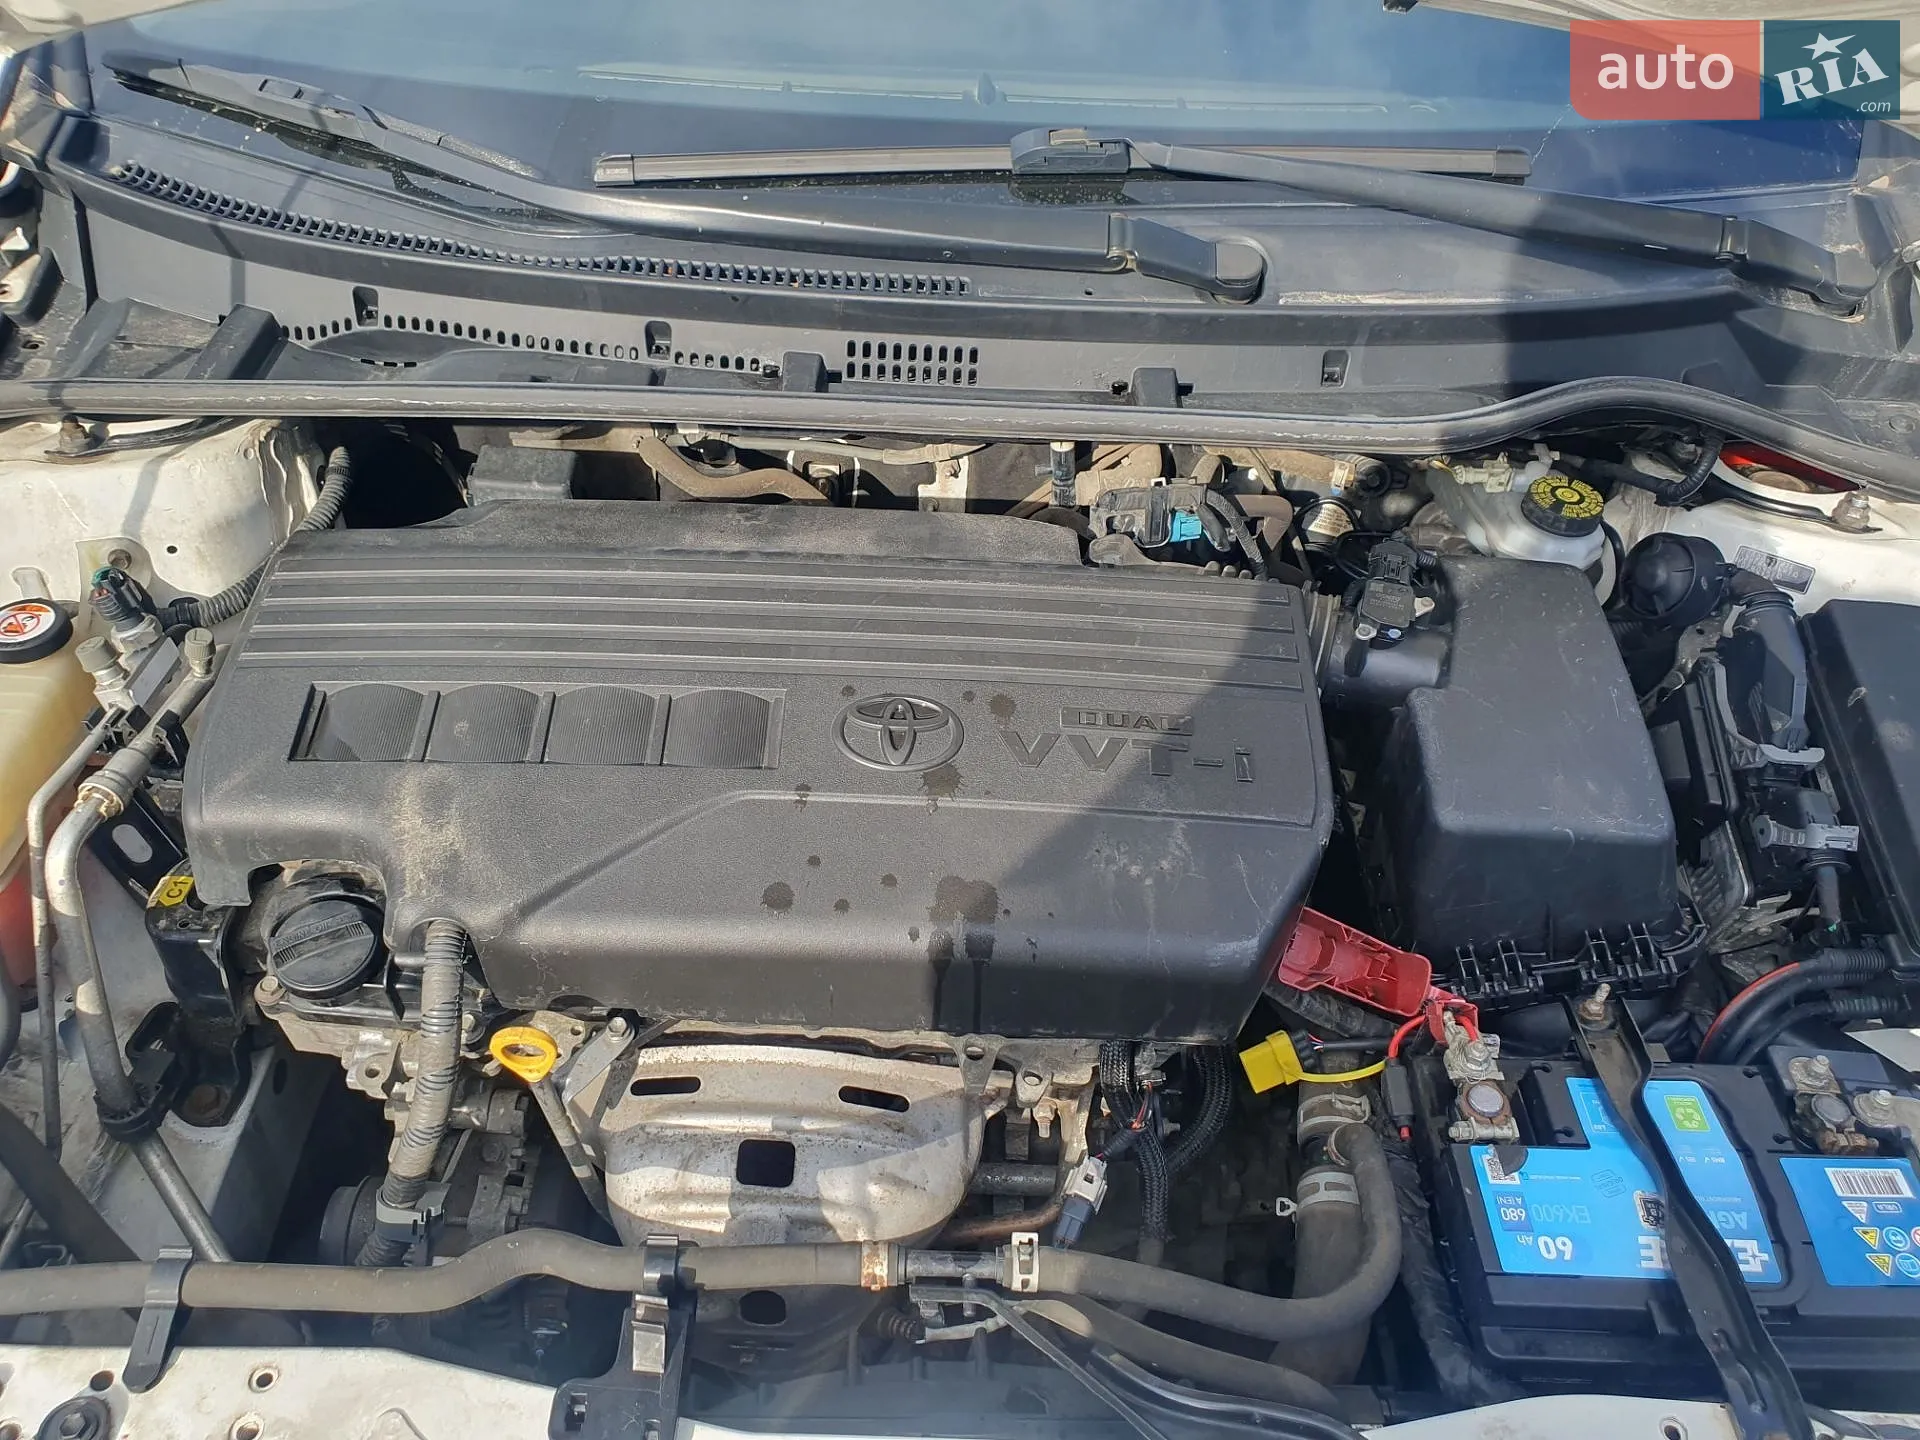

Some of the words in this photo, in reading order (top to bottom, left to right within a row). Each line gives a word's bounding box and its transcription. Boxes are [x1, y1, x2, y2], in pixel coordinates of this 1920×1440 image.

[1077, 709, 1180, 731] DUAL
[166, 880, 189, 899] C1
[1500, 1207, 1526, 1222] 680
[1531, 1204, 1591, 1224] EK600
[1516, 1234, 1534, 1246] Ah
[1537, 1235, 1574, 1261] 60
